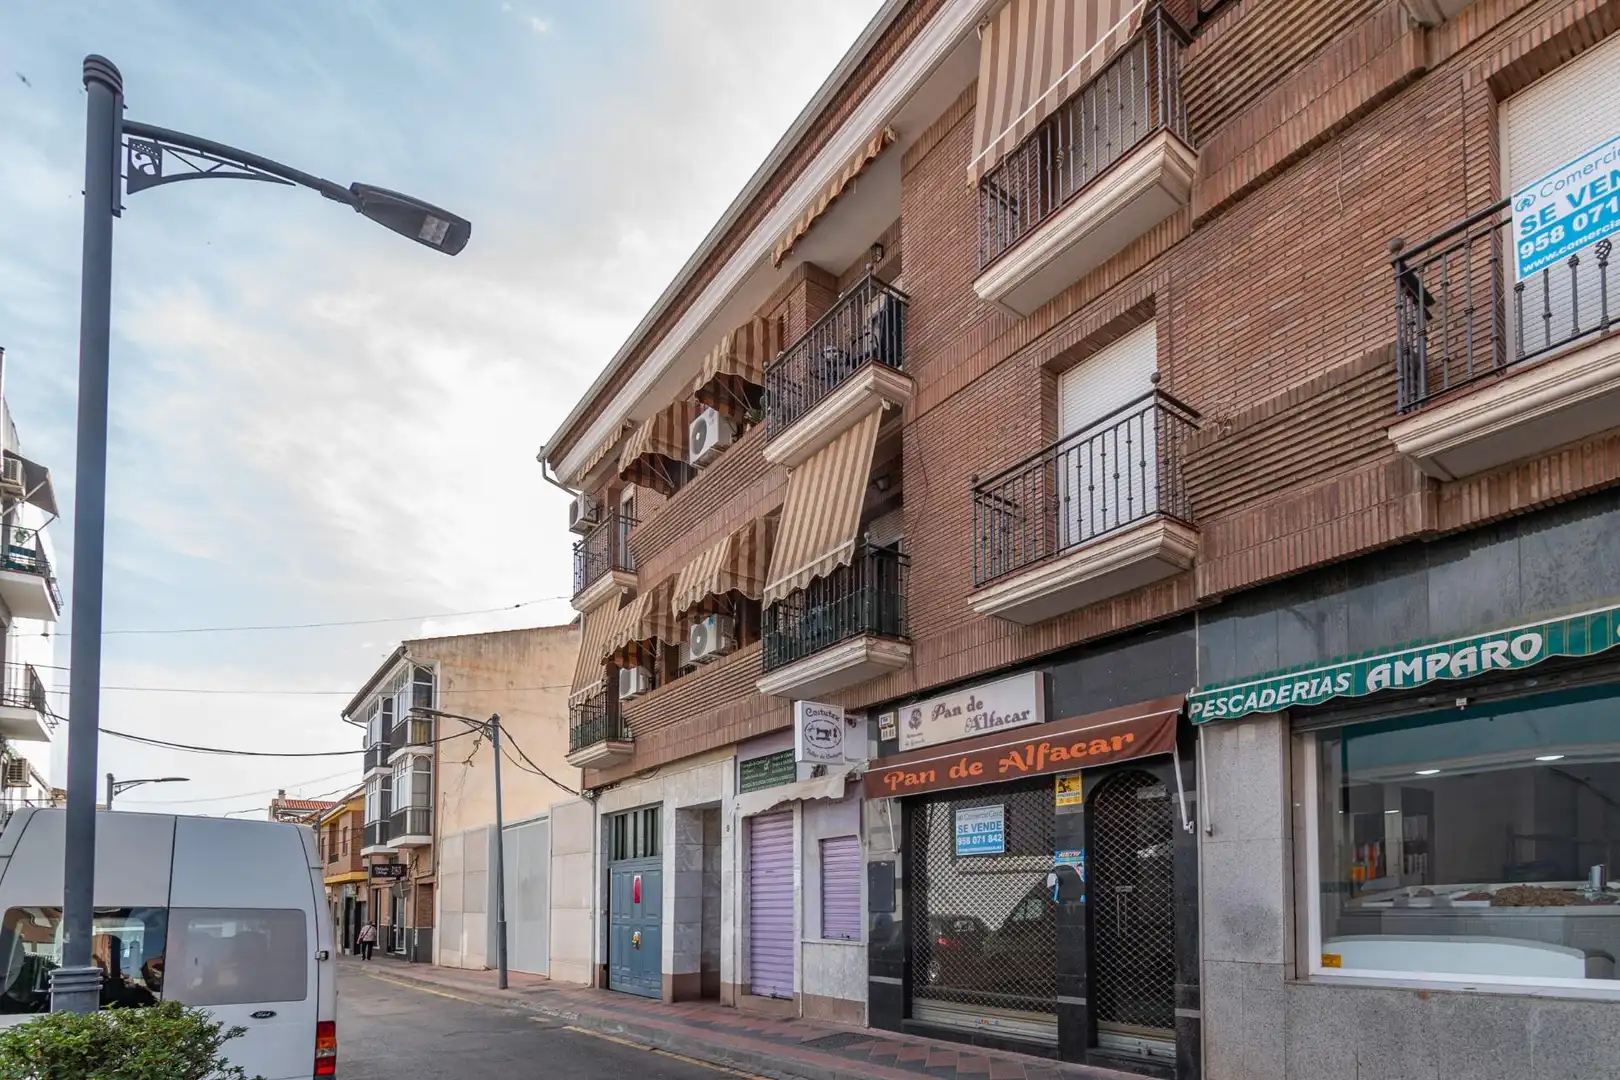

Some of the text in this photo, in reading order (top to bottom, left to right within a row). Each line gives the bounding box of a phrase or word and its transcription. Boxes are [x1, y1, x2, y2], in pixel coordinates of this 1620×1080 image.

[1520, 202, 1556, 236] SE
[1520, 195, 1619, 260] 958 071
[1366, 632, 1543, 693] AMPARO
[931, 695, 984, 722] Pan de
[1188, 672, 1352, 719] PESCADERIAS
[965, 709, 1030, 733] Alfacar
[884, 732, 1134, 791] Pan de Alfacar
[957, 820, 1002, 834] SE VENDE
[972, 835, 986, 844] 071
[988, 833, 1002, 843] 842
